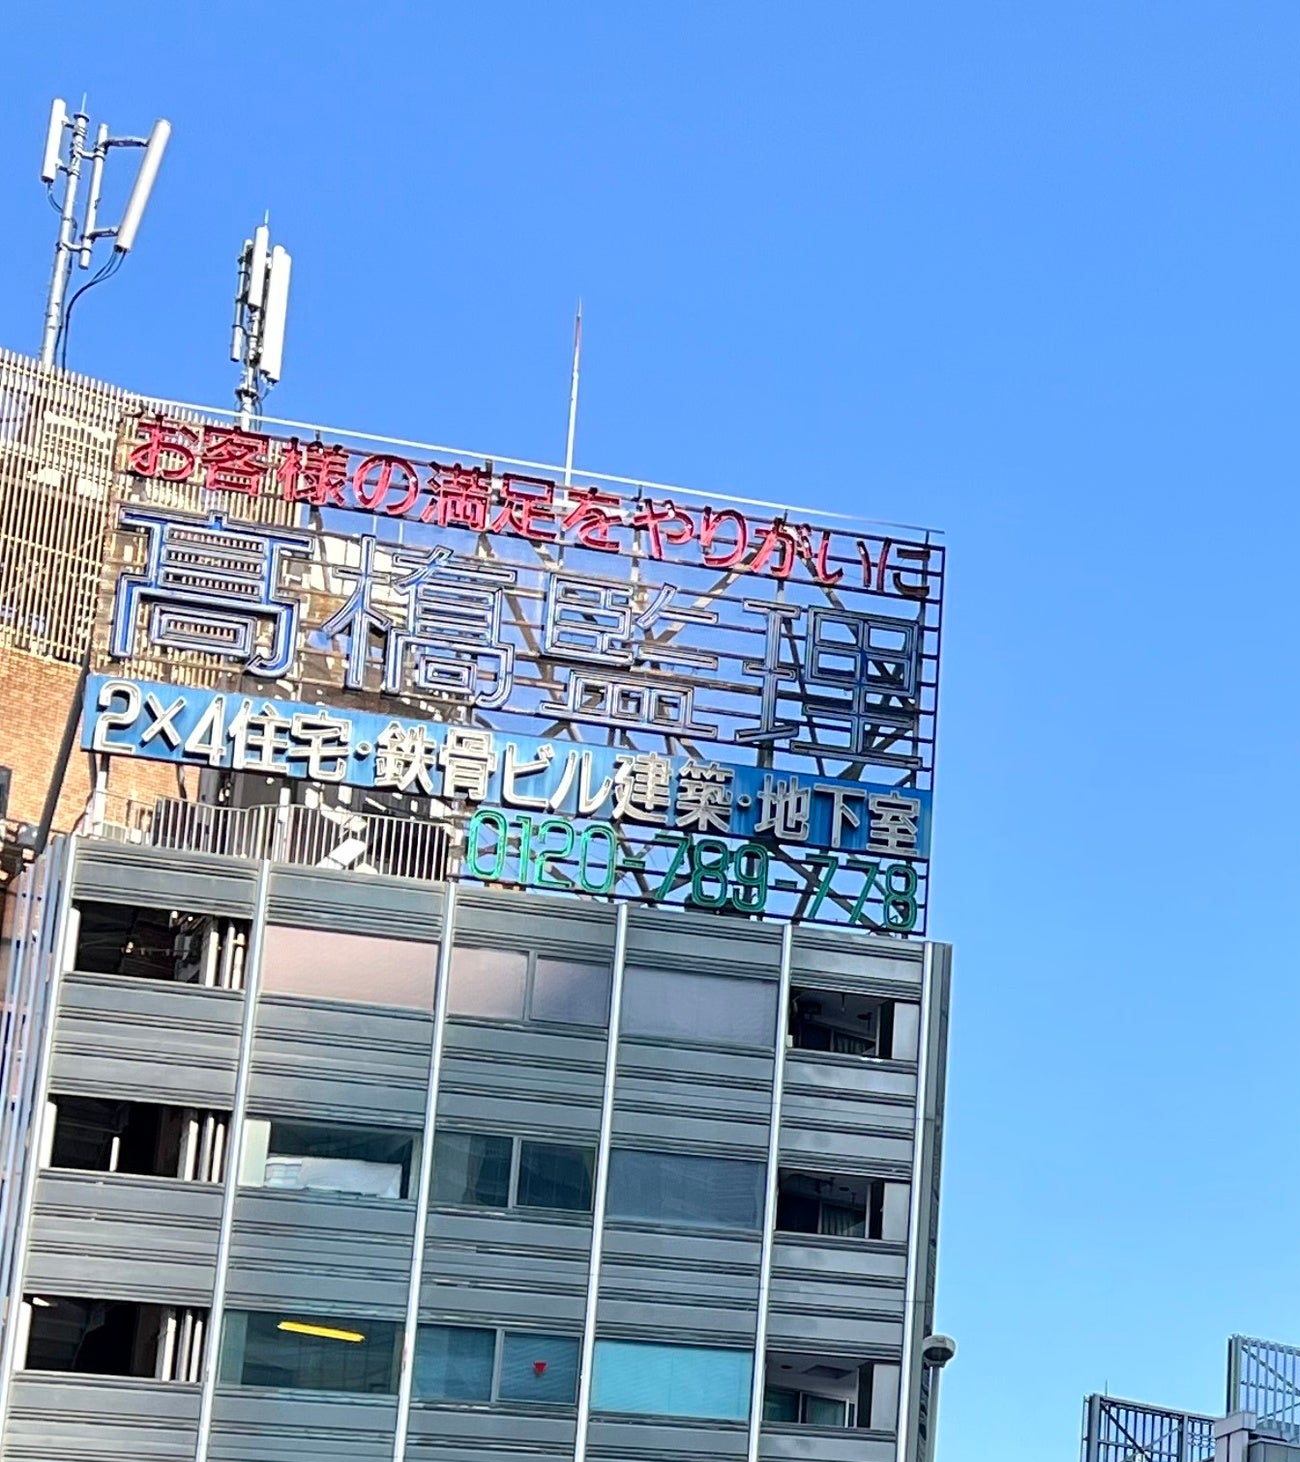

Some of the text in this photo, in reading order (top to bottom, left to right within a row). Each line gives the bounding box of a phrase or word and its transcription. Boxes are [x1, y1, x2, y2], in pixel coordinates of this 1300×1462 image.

[127, 412, 932, 597] お客様の満足をやりがいに
[467, 809, 919, 931] 0120-789-778
